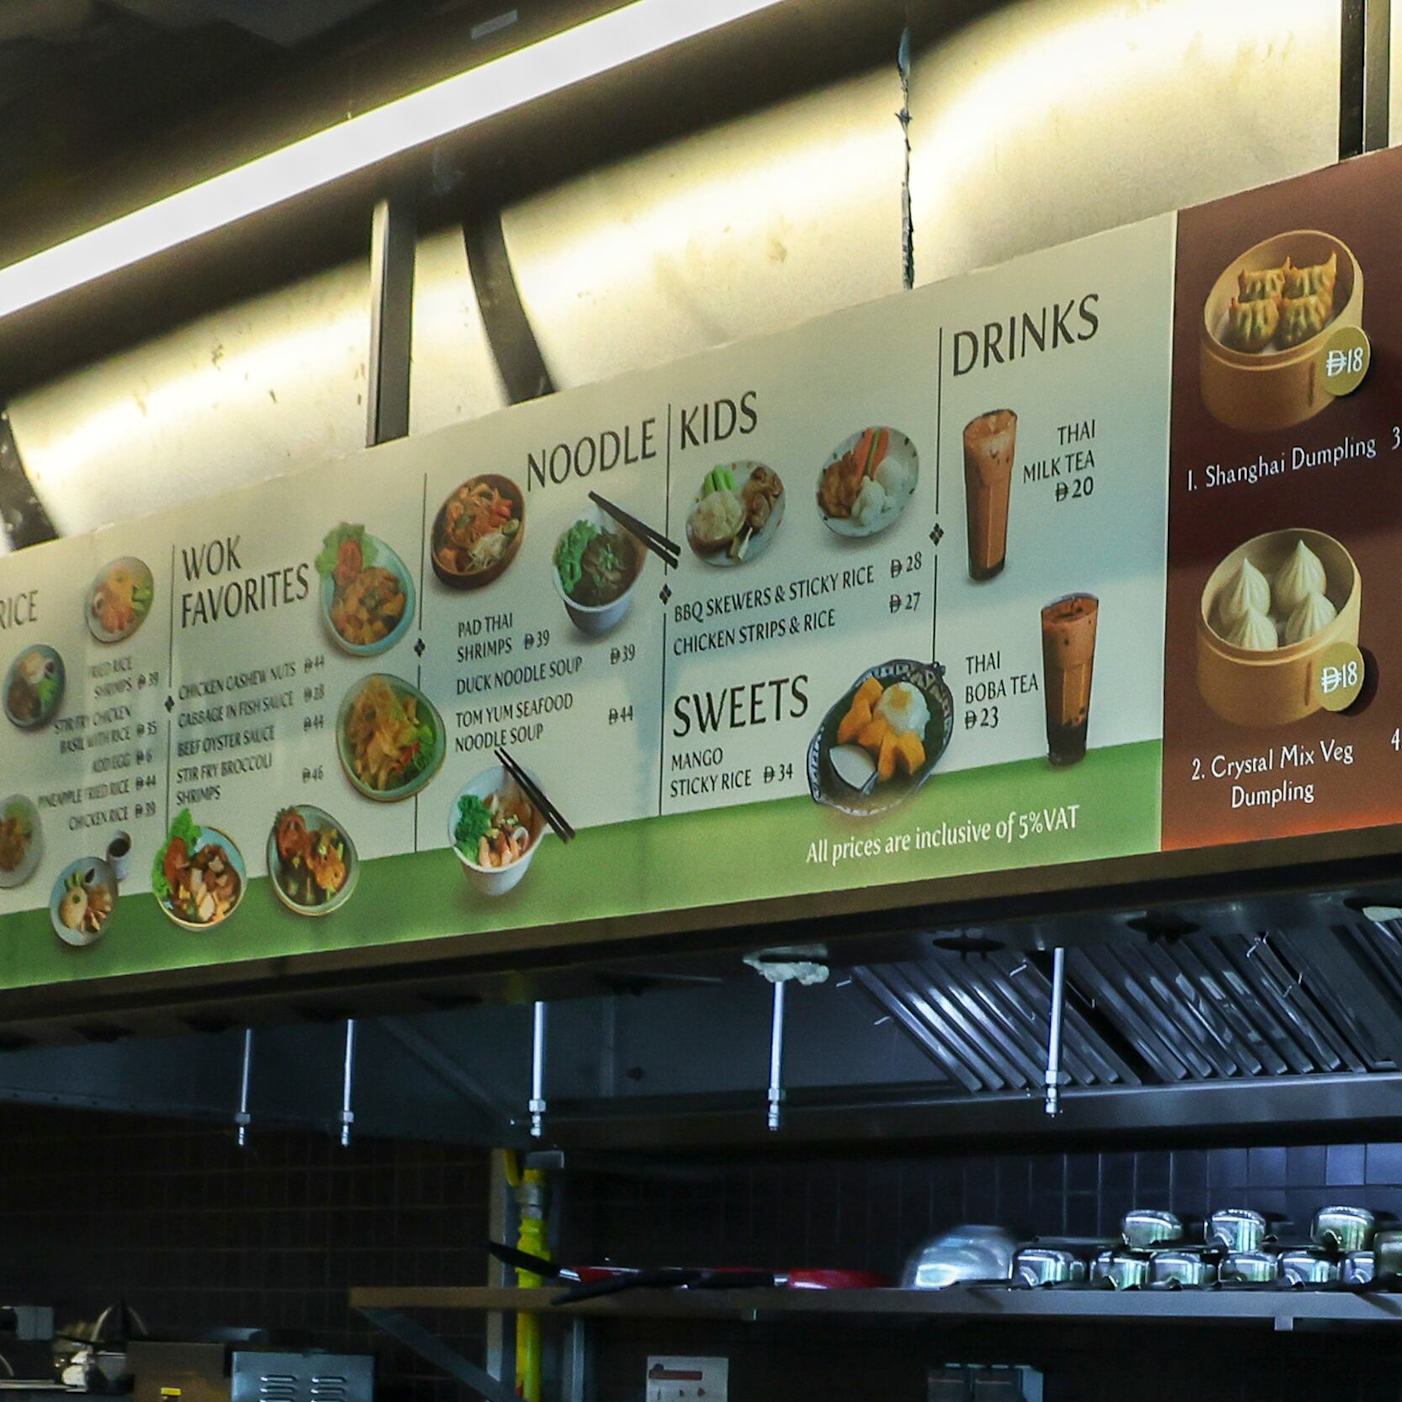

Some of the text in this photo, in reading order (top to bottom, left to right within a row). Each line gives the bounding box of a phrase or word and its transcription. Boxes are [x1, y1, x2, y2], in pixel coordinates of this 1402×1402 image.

[953, 293, 1099, 376] DRINKS
[681, 390, 758, 450] KIDS
[1057, 419, 1096, 446] THAI
[527, 417, 657, 492] NOODLE
[1023, 449, 1095, 484] MILK TEA
[1187, 436, 1376, 491] 1. Shanghai Dumpling
[182, 535, 242, 581] WOK
[182, 563, 309, 629] FAVORITES
[674, 599, 703, 624] BBQ
[706, 587, 771, 617] SKEWERS
[775, 584, 786, 602] &
[789, 573, 839, 601] STICKY
[843, 565, 875, 587] RICE
[458, 612, 513, 639] PAD THAI
[673, 628, 735, 656] CHICKEN
[739, 617, 786, 645] STRIPS
[789, 615, 800, 633] &
[803, 608, 836, 633] RICE
[457, 638, 513, 663] SHRIMPS
[965, 650, 1000, 676] THAI
[456, 675, 492, 695] DUCK
[494, 663, 546, 688] NOODLE
[549, 656, 583, 679] SOUP
[965, 673, 1039, 704] BOBA TEA
[456, 692, 574, 728] TOM YUM SEAFOOD
[672, 674, 809, 738] SWEETS
[455, 722, 544, 753] NOODLE SOUP
[671, 747, 723, 772] MANGO
[1192, 739, 1354, 780] 2. Crystal Mix Veg
[670, 773, 719, 799] STICKY
[721, 769, 752, 791] RICE
[1231, 780, 1315, 808] Dumpling
[806, 838, 828, 863] All
[831, 835, 881, 867] prices
[884, 834, 911, 855] are
[915, 820, 991, 850] inclusive
[996, 811, 1017, 844] of
